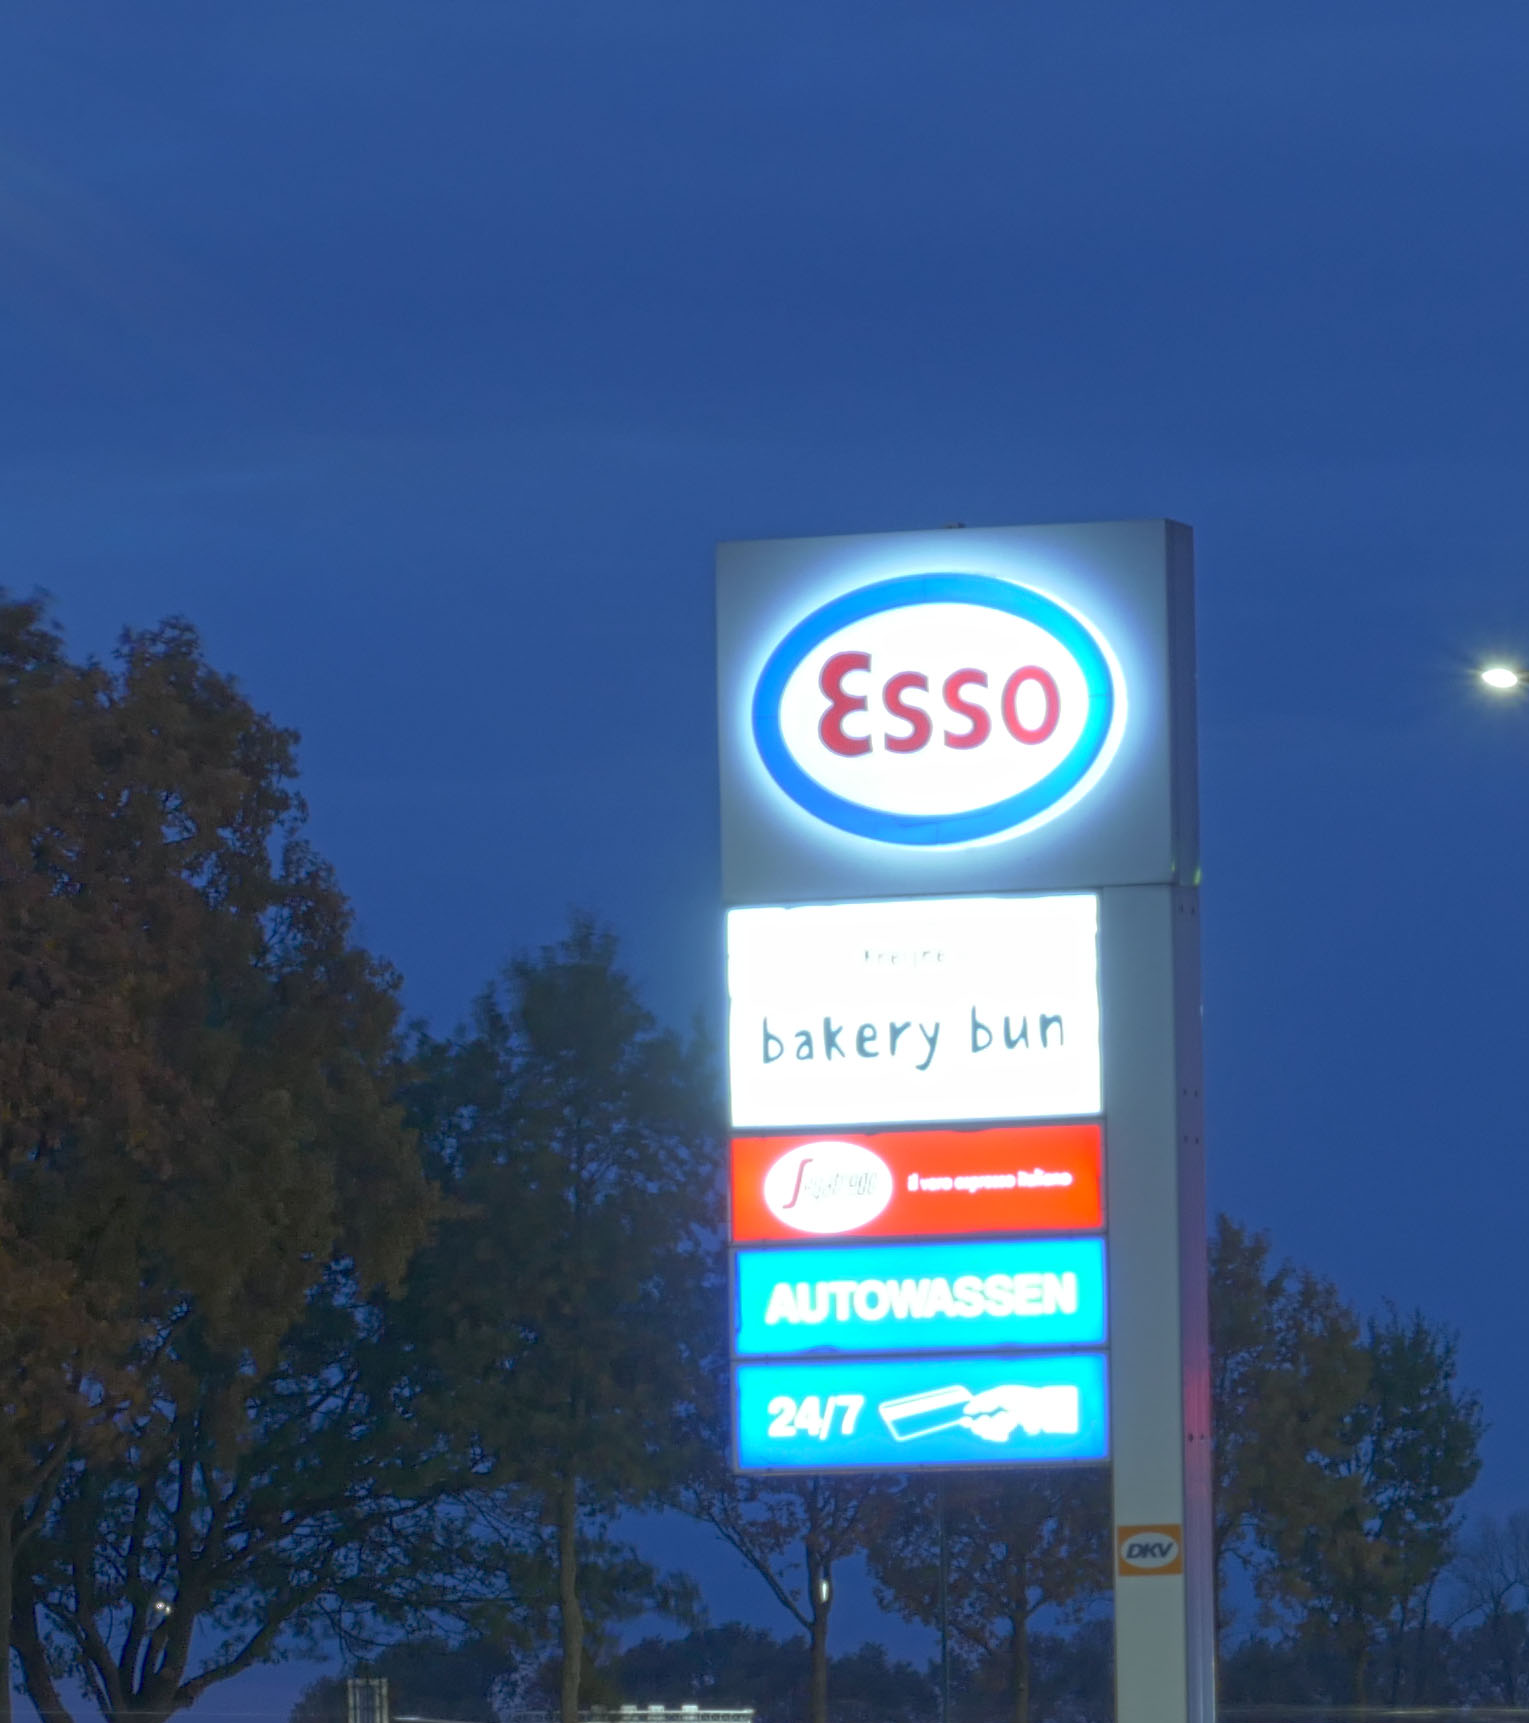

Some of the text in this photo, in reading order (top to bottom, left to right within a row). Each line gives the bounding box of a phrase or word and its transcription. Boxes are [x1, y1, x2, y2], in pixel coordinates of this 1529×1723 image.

[762, 1004, 1064, 1071] bakery bun
[765, 1272, 1079, 1325] AUTOWASSEN
[767, 1394, 865, 1440] 24/7
[1126, 1542, 1174, 1559] DKV
